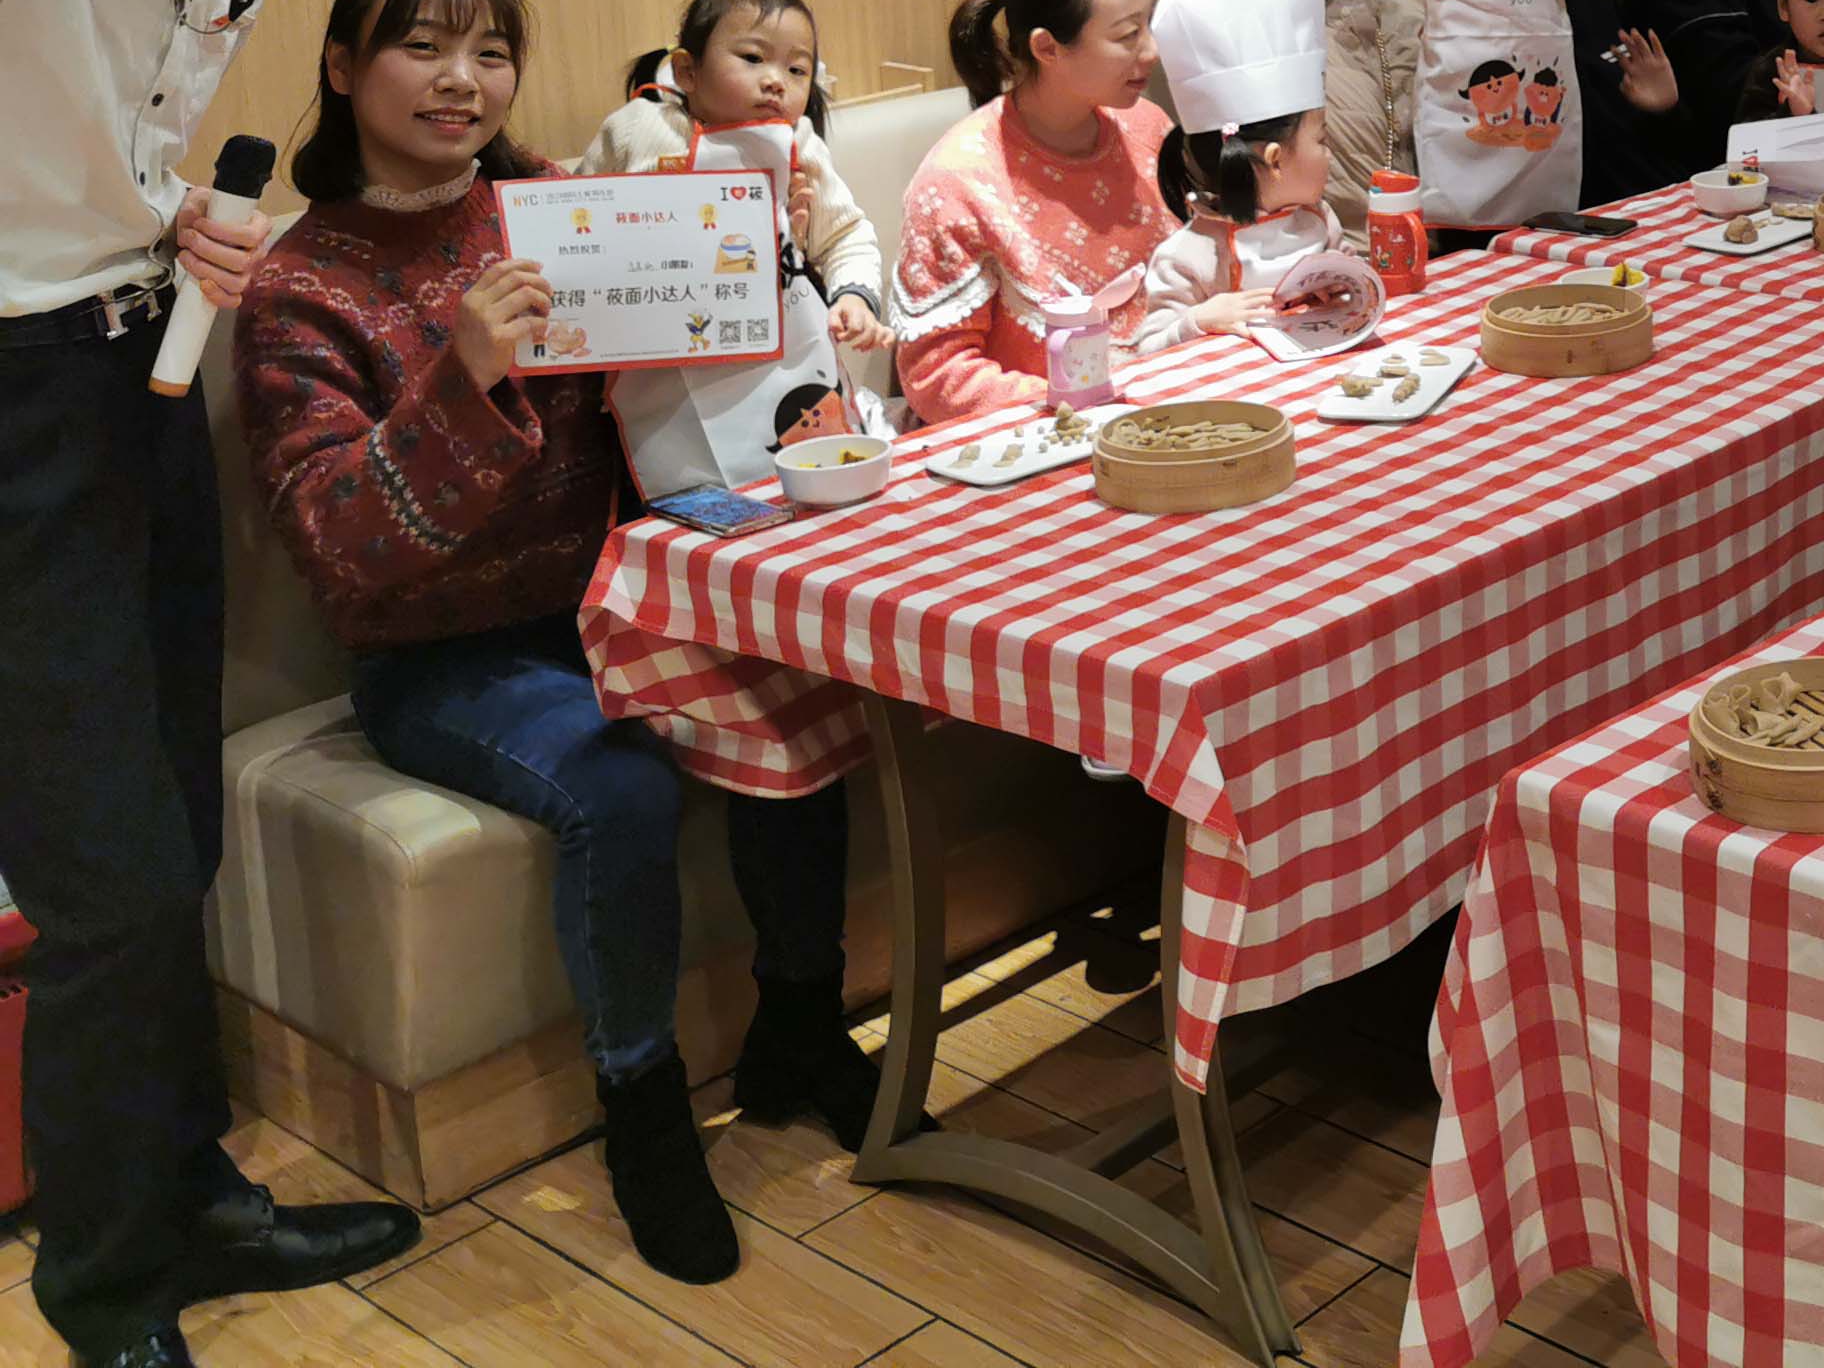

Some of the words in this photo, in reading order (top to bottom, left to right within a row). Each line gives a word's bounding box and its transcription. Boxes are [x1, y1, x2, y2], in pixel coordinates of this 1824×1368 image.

[616, 211, 678, 224] 莜面小达人
